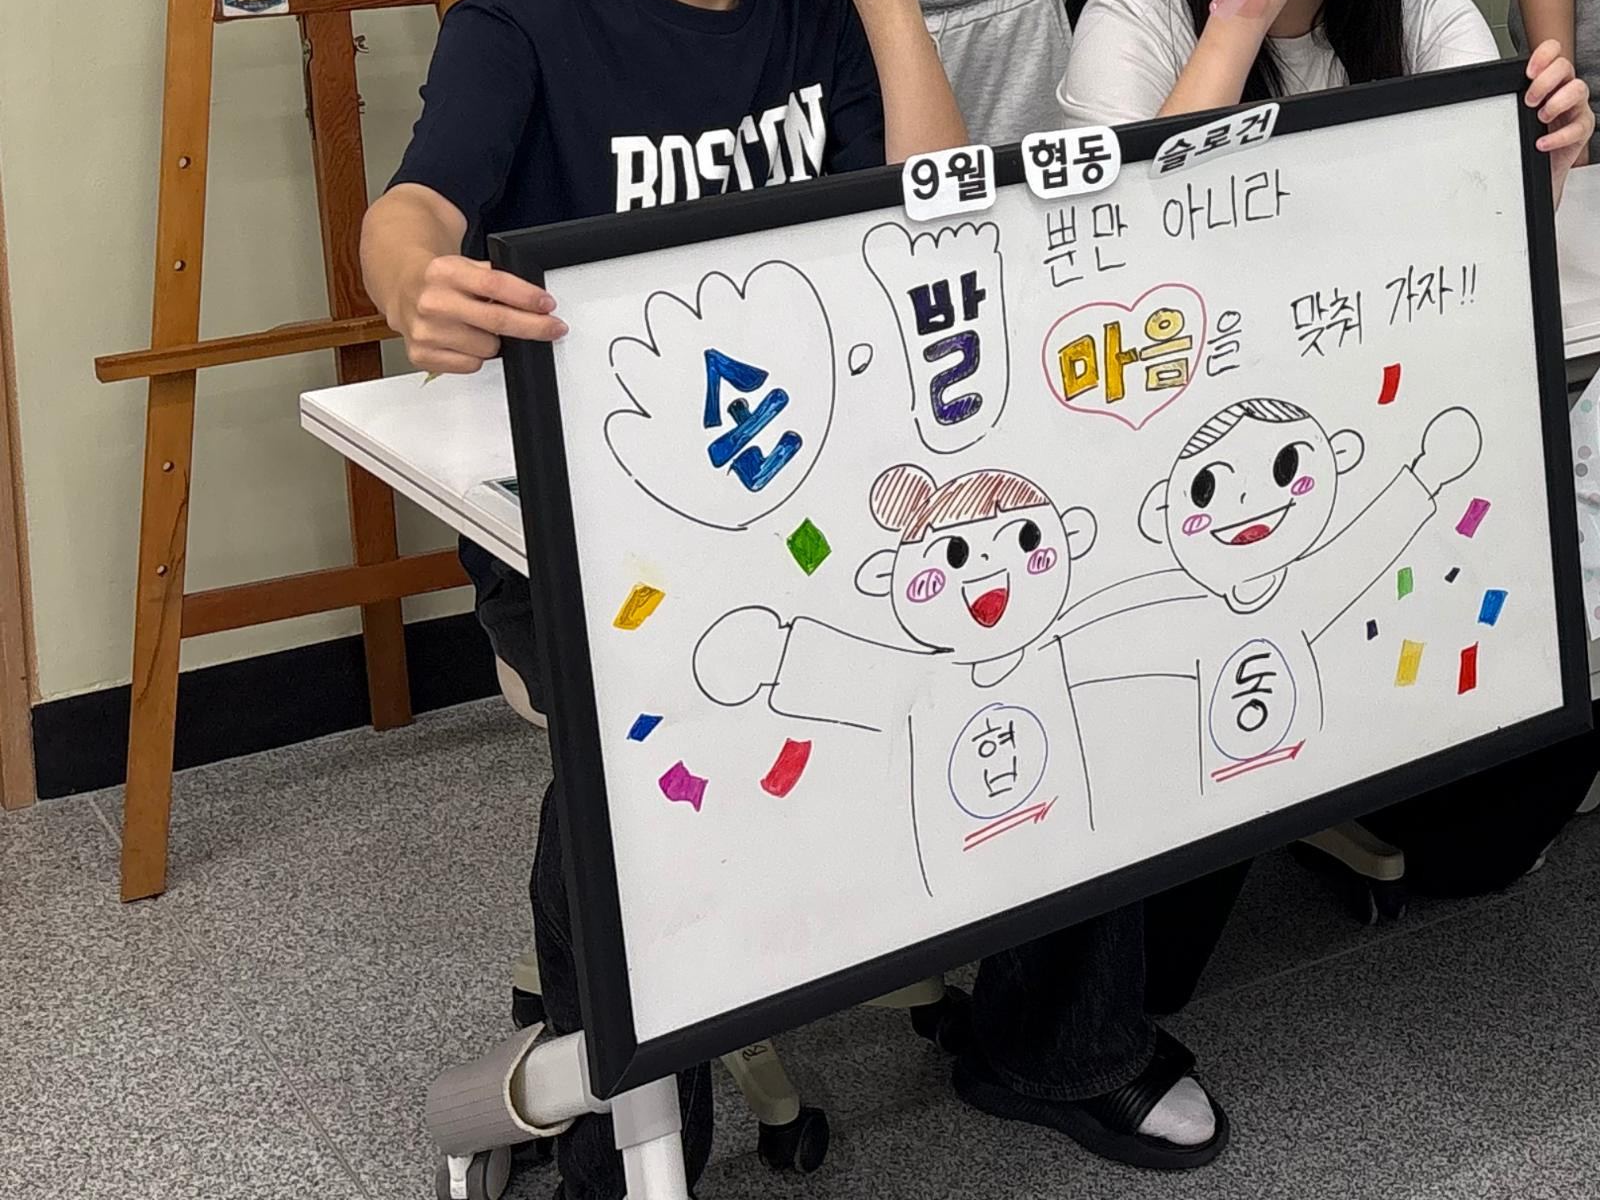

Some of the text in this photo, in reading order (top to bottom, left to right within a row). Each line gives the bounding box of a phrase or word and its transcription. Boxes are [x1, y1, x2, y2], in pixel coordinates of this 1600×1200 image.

[910, 107, 1273, 202] 9월 협동 슬로건
[1043, 203, 1128, 288] 뿐만
[1163, 168, 1291, 241] 아니라
[1290, 287, 1362, 359] 맞춰
[1385, 263, 1477, 326] 가자!!
[1231, 651, 1277, 732] 동
[972, 717, 1017, 798] 협
